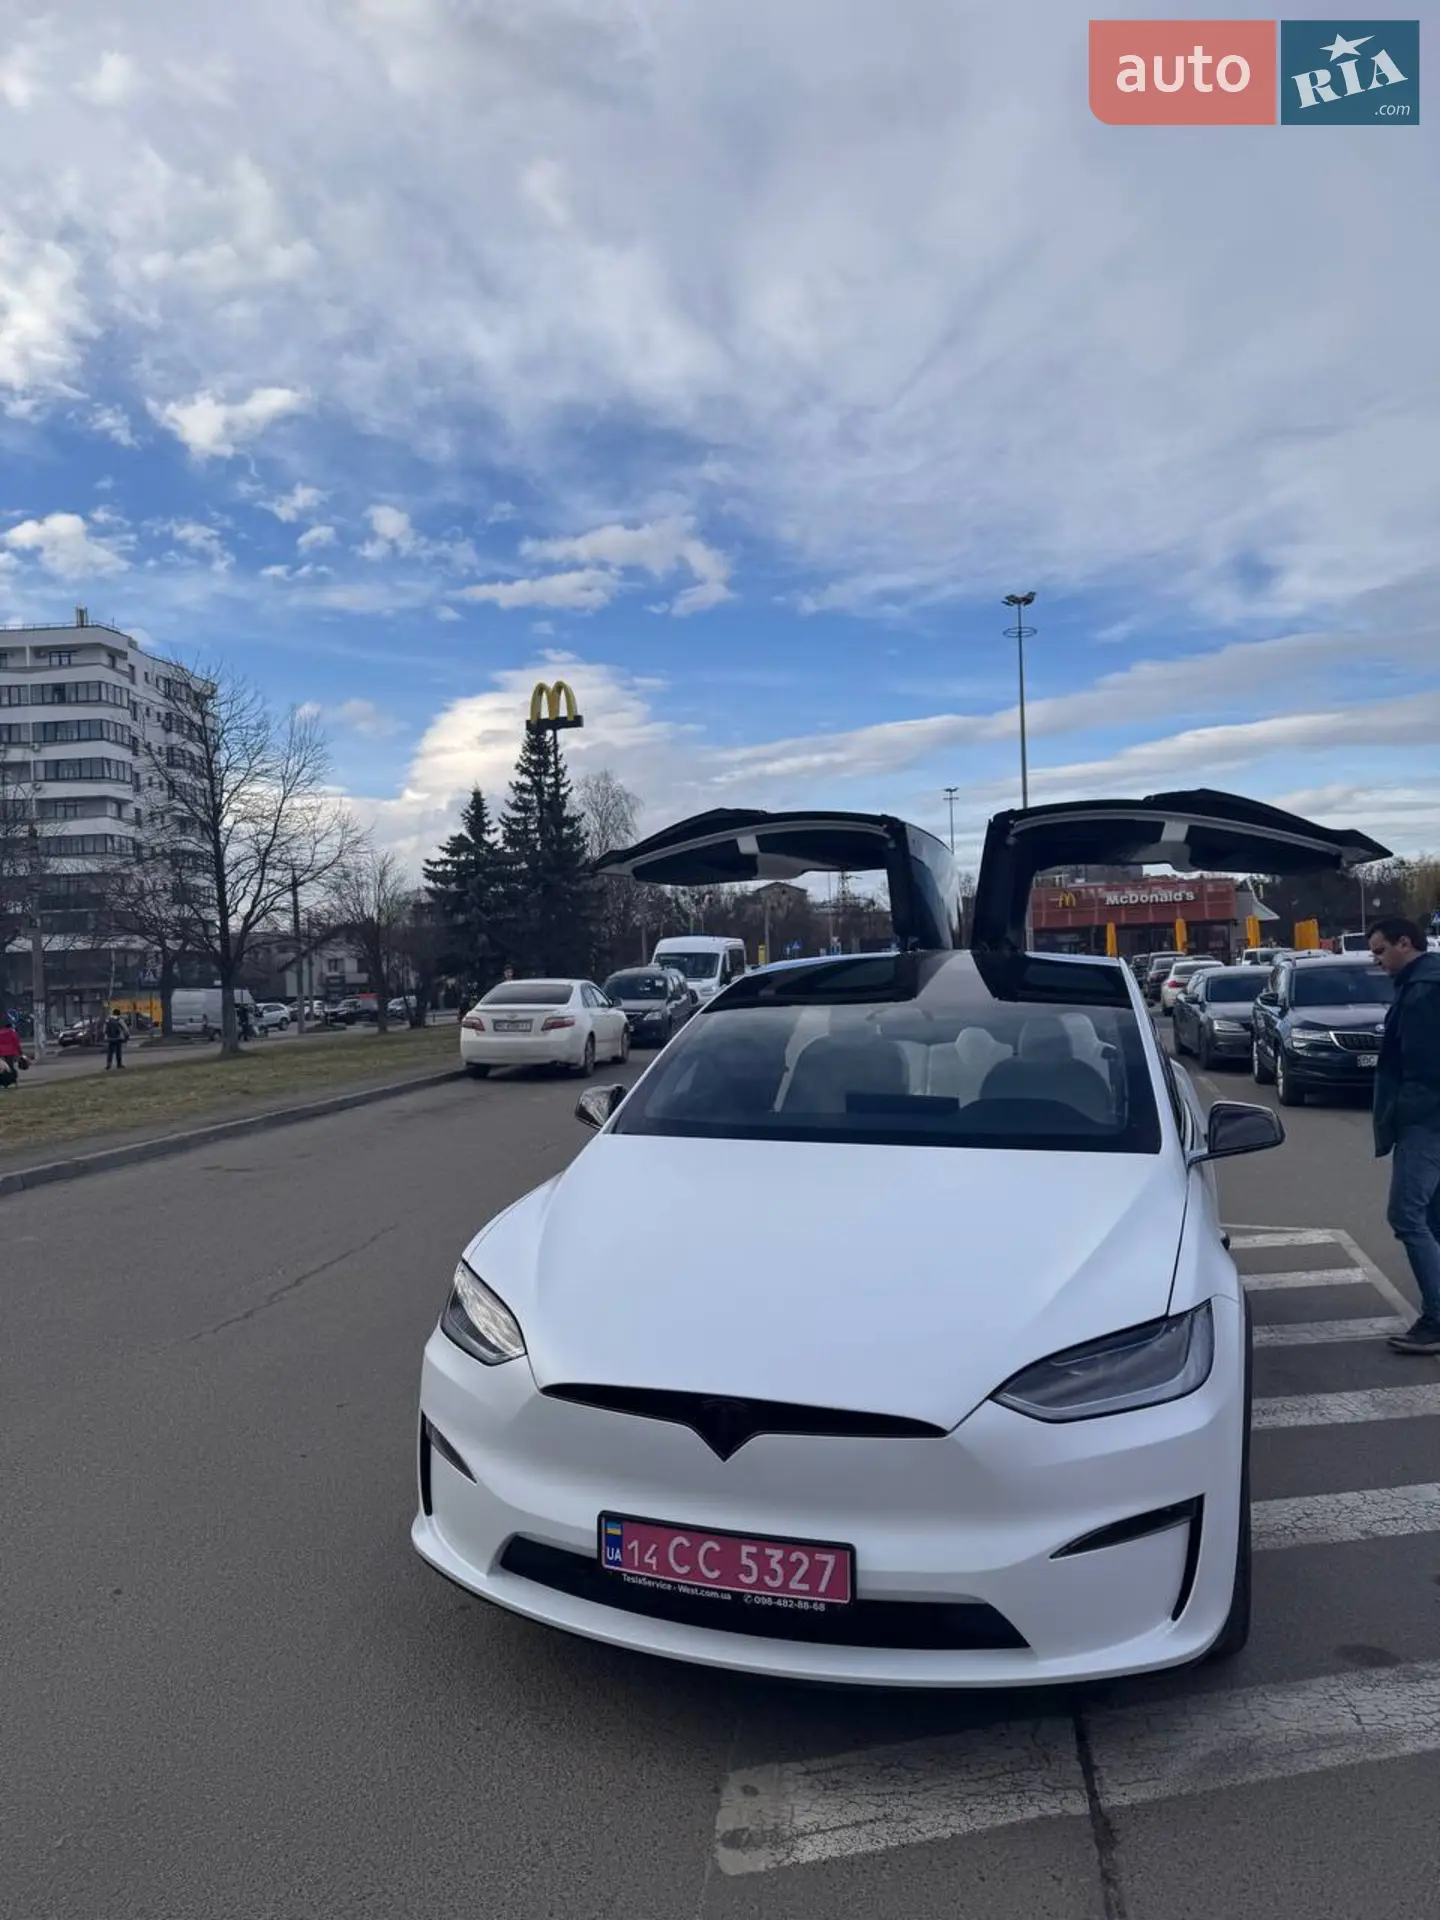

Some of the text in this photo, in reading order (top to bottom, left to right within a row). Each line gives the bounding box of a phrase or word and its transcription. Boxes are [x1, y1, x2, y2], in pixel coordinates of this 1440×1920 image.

[1106, 889, 1196, 906] McDonald's
[606, 1547, 623, 1562] UA
[738, 1544, 836, 1593] 5327
